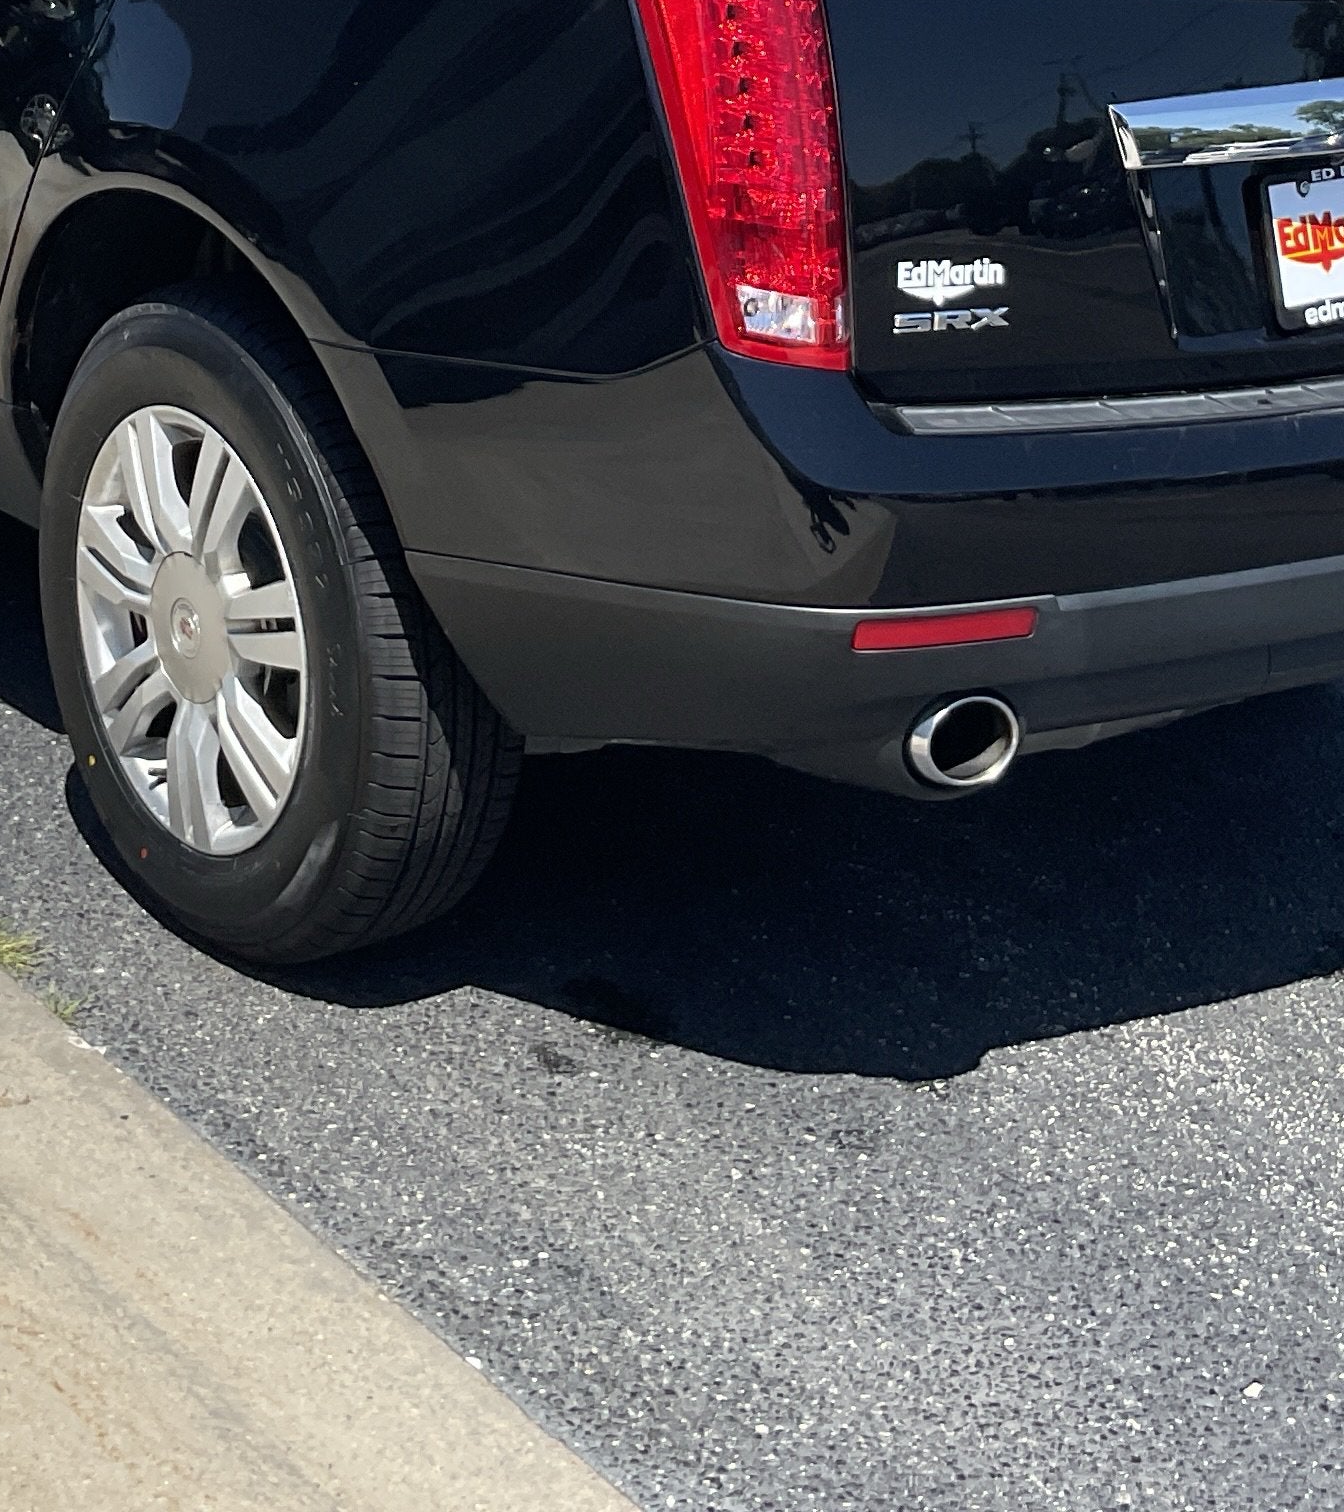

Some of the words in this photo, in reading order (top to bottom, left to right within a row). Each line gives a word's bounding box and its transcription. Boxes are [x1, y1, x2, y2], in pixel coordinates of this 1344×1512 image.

[1310, 167, 1336, 182] ED
[897, 257, 1006, 288] EdMartin
[893, 306, 1010, 334] SRX
